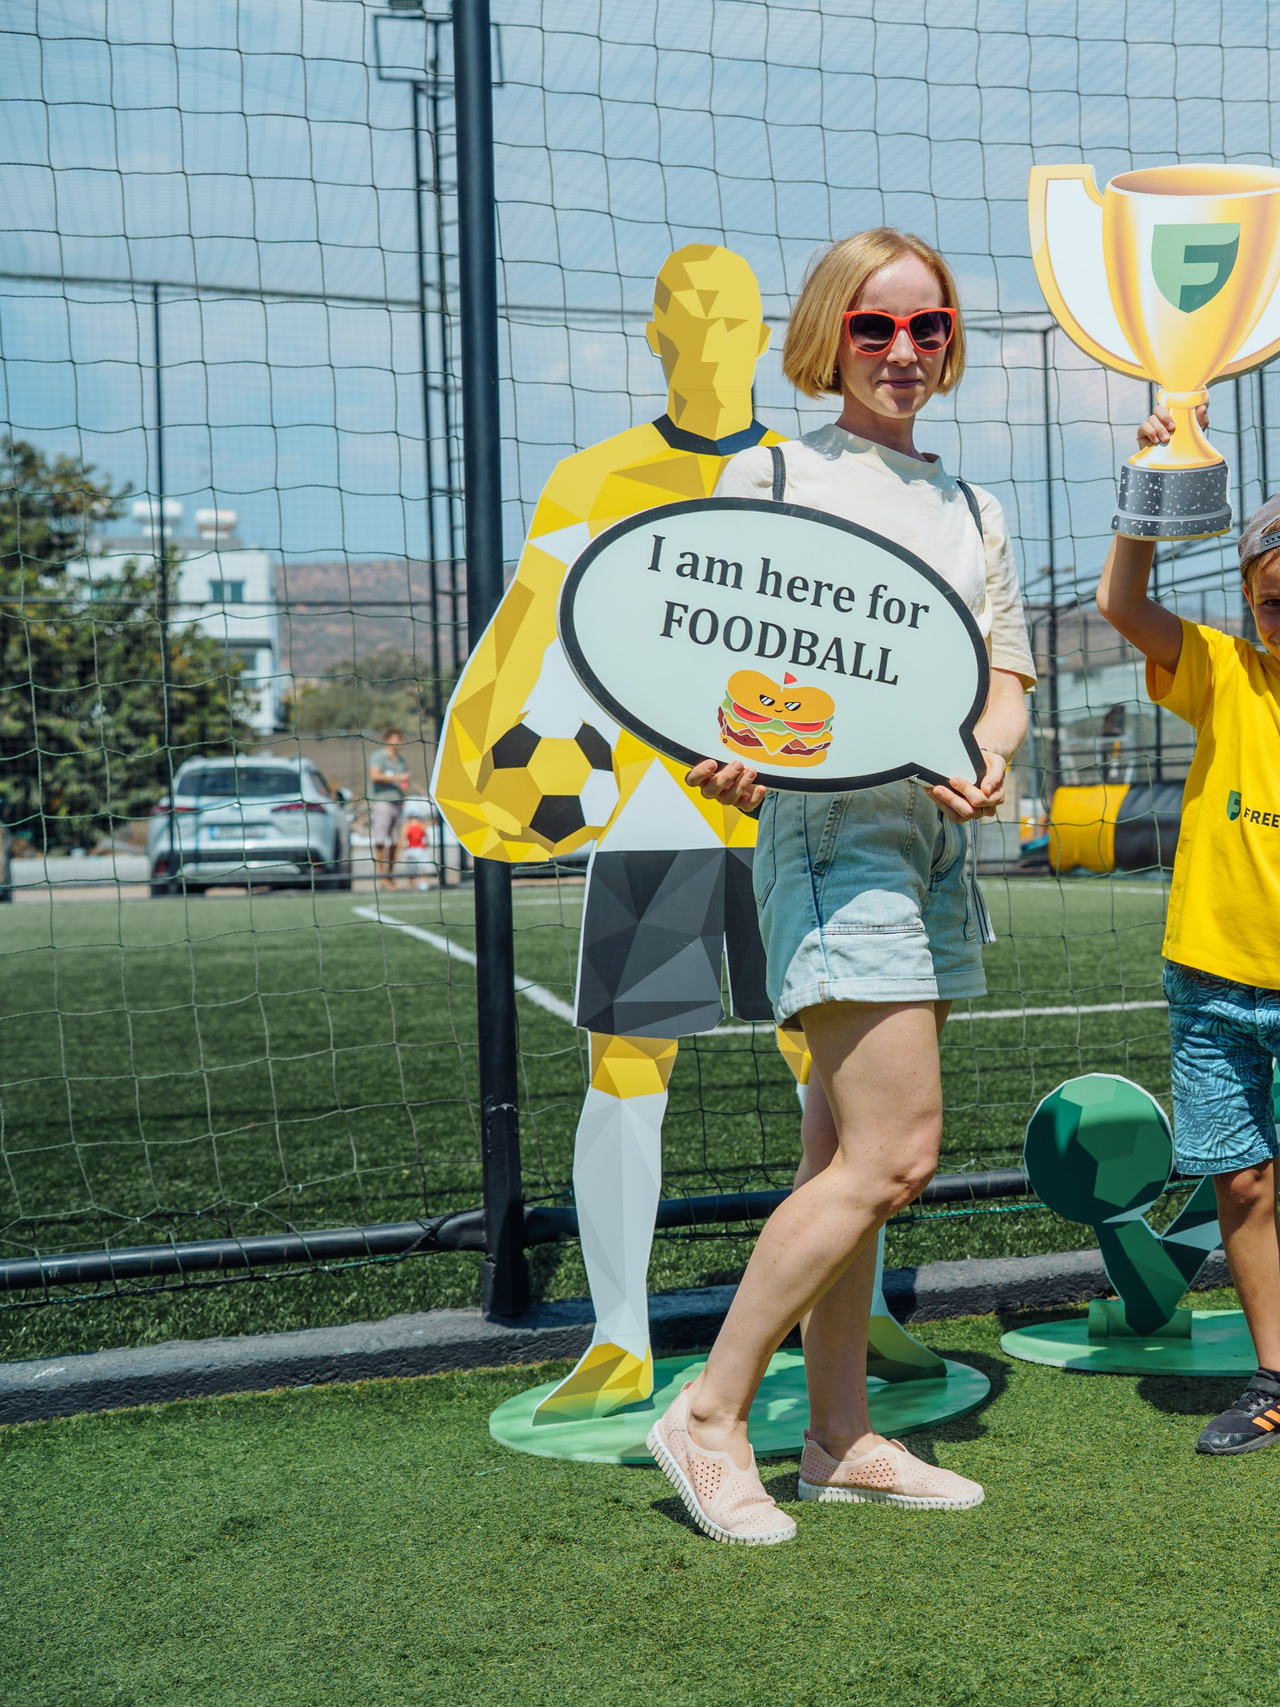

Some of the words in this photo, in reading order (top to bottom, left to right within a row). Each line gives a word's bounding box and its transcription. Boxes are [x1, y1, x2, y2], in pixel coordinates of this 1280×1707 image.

[647, 534, 666, 573] I
[675, 551, 743, 590] am
[755, 557, 855, 613] here
[867, 584, 930, 630] for
[659, 600, 899, 686] FOODBALL
